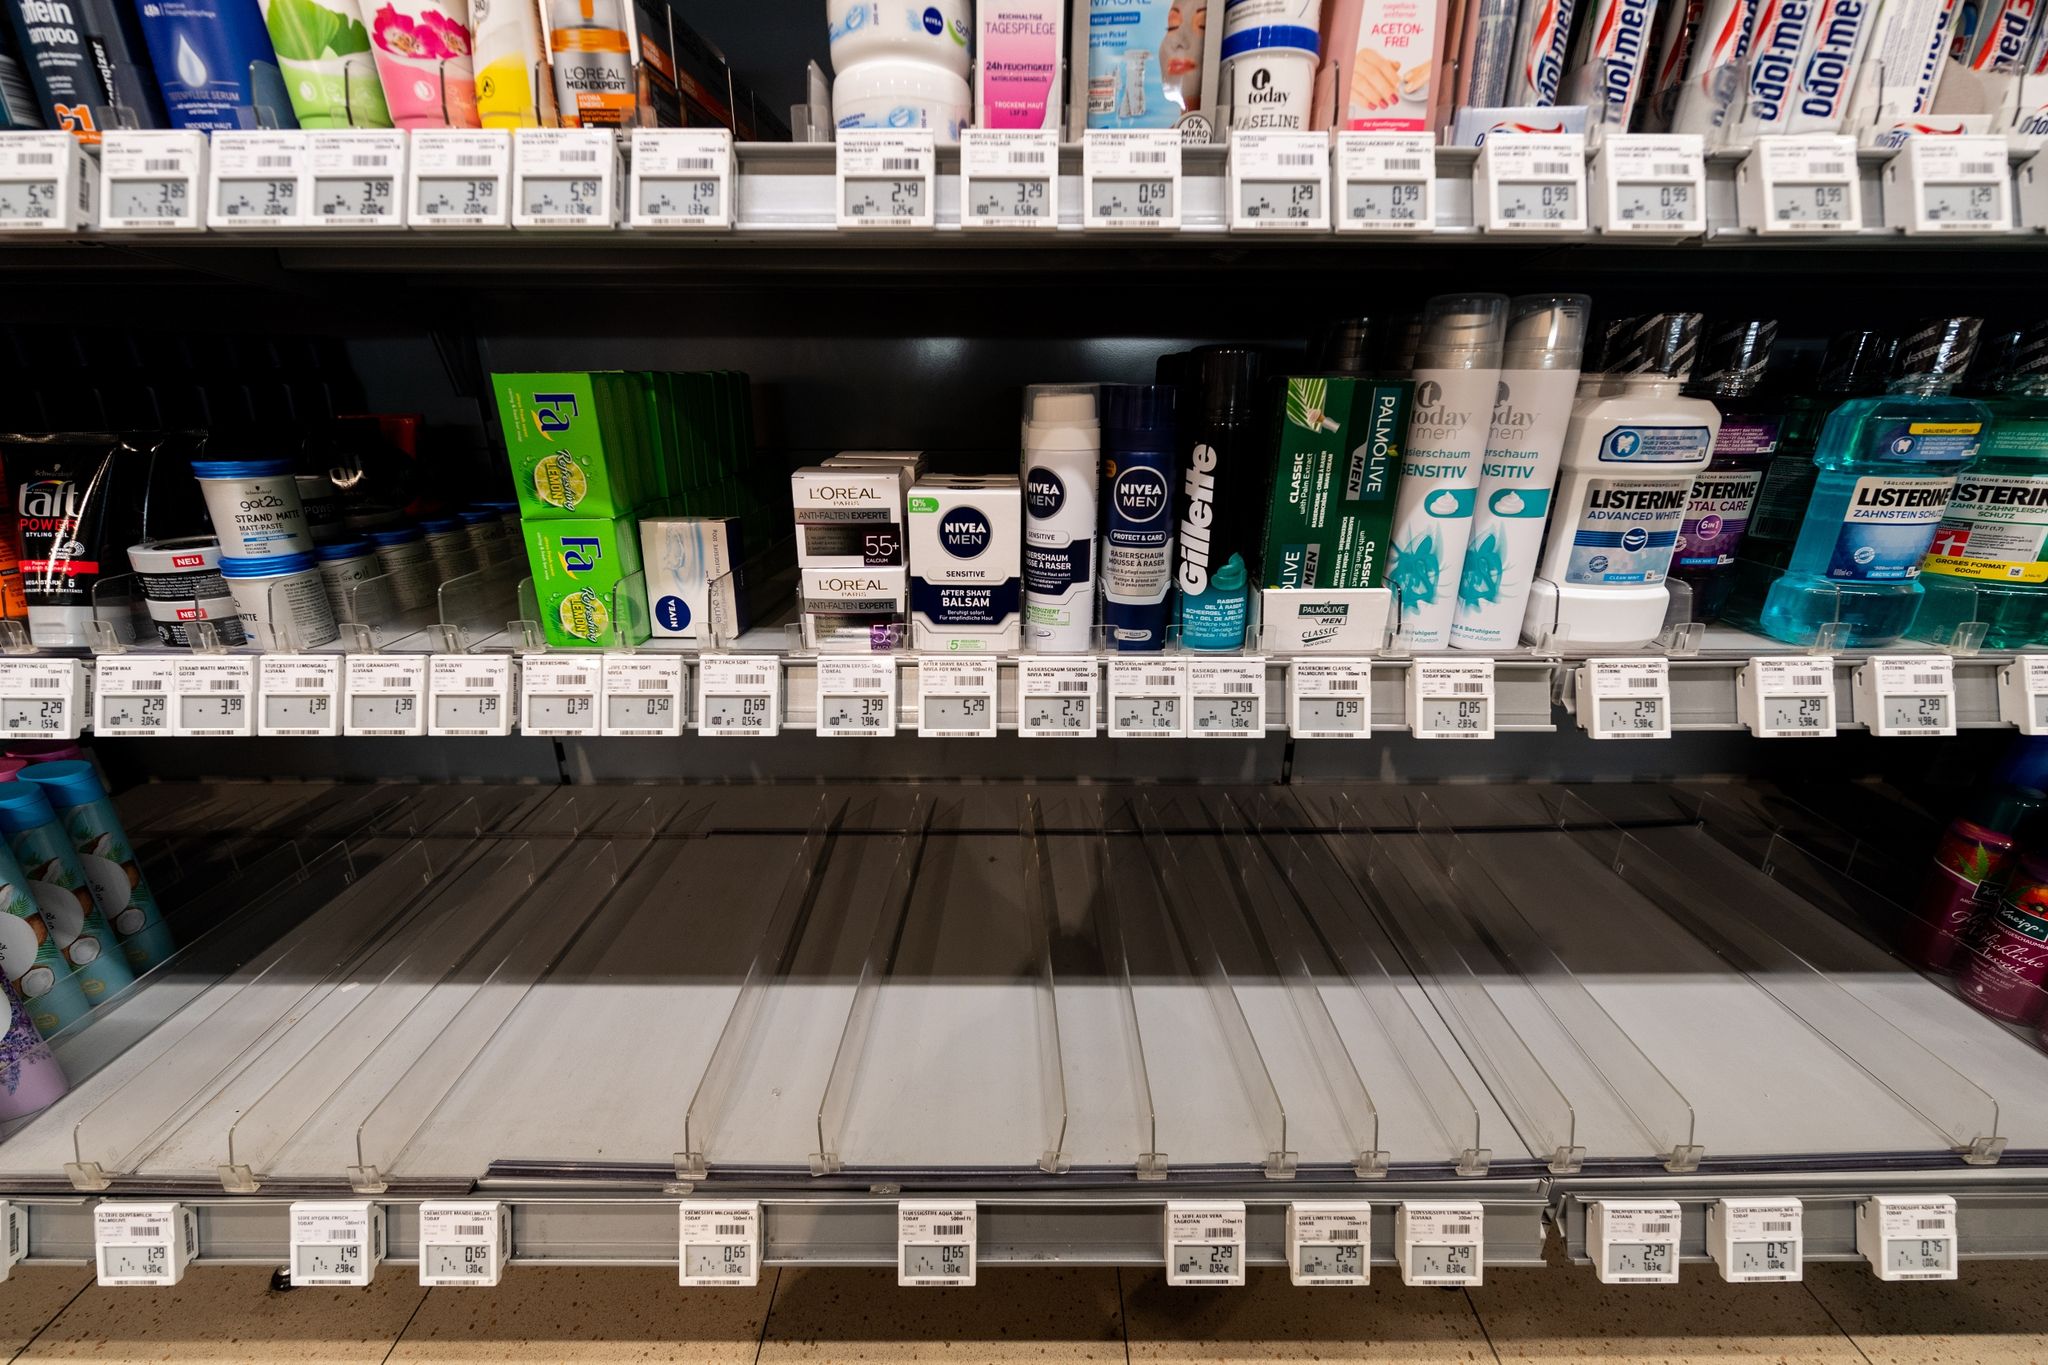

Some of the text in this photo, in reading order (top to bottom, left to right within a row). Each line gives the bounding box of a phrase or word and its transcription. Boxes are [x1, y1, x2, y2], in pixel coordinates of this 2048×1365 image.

[924, 16, 942, 28] NIVEA
[998, 13, 1043, 21] REICHHALTIGE
[985, 22, 1056, 36] TAGESPFLEGE
[1371, 24, 1424, 35] ACETON-
[1384, 37, 1410, 48] FREI
[986, 61, 1054, 72] 24h FEUCHTIGKEIT
[566, 81, 627, 90] MEN EXPERT
[1248, 87, 1290, 106] today
[994, 101, 1044, 110] TROCKENE HAUT
[1187, 119, 1203, 129] 0%
[1181, 130, 1208, 139] MIKRO
[267, 182, 294, 205] 3.99
[363, 182, 390, 205] 3.99
[467, 182, 493, 204] 3.99
[891, 182, 919, 204] 2.49
[1017, 182, 1043, 204] 3.29
[1138, 182, 1166, 205] 0.69
[1291, 184, 1314, 206] 1.29
[1391, 184, 1419, 206] 0.99
[533, 392, 578, 432] Fa
[1415, 427, 1457, 440] men
[1366, 395, 1396, 494] PALMOLIVE
[546, 462, 562, 501] LEMON
[556, 447, 576, 513] Refreshing
[1289, 452, 1305, 504] CLASSIC
[1348, 454, 1364, 493] MEN
[809, 485, 882, 500] L'ORÉAL
[1120, 483, 1162, 495] NIVEA
[1299, 453, 1313, 515] with Palm Extract
[1690, 481, 1757, 499] STERINE
[18, 480, 79, 517] taft
[239, 495, 284, 512] got2b
[912, 499, 927, 508] 0%
[1123, 496, 1158, 507] MEN
[1589, 490, 1688, 510] LISTERINE
[1720, 500, 1749, 511] CARE
[1856, 488, 1951, 507] LISTERINE
[1950, 502, 1976, 510] ZAHN
[234, 509, 300, 524] STRAND MATTE
[798, 511, 889, 521] ANTI-FALTEN EXPERTE
[1179, 443, 1218, 596] Gillette
[1587, 510, 1682, 521] ADVANCED WHITE
[1853, 509, 1944, 519] ZAHNSTEIN SCHUTZ
[1977, 511, 2015, 520] SCHUTZ
[19, 518, 78, 532] POWER
[239, 522, 285, 532] MATT-PASTE
[944, 522, 987, 534] NIVEA
[865, 534, 900, 556] 55+
[948, 534, 983, 545] MEN
[1113, 533, 1163, 541] PROTECT & CARE
[176, 555, 200, 567] NEU
[560, 536, 602, 573] Fa
[1110, 550, 1164, 560] RASIERSCHAUM
[1047, 560, 1072, 570] RASER
[1108, 559, 1165, 568] MOUSSE RASER
[1303, 550, 1318, 587] MEN
[1360, 541, 1375, 587] CLASSIC
[1954, 567, 1981, 575] 600ml
[1970, 562, 2006, 571] FORMAT
[945, 570, 986, 578] SENSITIVE
[68, 578, 75, 588] 5
[818, 577, 888, 591] L'ORÉAL
[940, 589, 992, 597] AFTER SHAVE
[807, 601, 895, 610] ANTI-FALTEN EXPERTE
[942, 597, 990, 607] BALSAM
[1302, 604, 1345, 615] PALMOLIVE
[570, 598, 583, 633] LEMON
[581, 585, 598, 643] Refreshing
[668, 599, 679, 628] NIVEA
[949, 614, 979, 622] empfindliche
[1320, 617, 1343, 625] MEN
[1301, 626, 1339, 640] CLASSIC
[40, 701, 62, 718] 2.29
[142, 698, 164, 716] 2.29
[220, 698, 242, 715] 3.99
[309, 698, 326, 715] 1.39
[395, 698, 412, 715] 1.39
[479, 698, 496, 715] 1.39
[567, 698, 589, 715] 0.39
[647, 698, 669, 716] 0.50
[743, 698, 766, 716] 0.69
[862, 699, 884, 716] 3.99
[963, 699, 985, 716] 5.29
[1062, 699, 1084, 717] 2.19
[1151, 699, 1174, 717] 2.19
[1230, 699, 1253, 717] 2.59
[1335, 700, 1358, 718] 0.99
[1458, 700, 1481, 718] 0.85
[1634, 700, 1657, 718] 2.99
[1799, 698, 1821, 717] 2.99
[1919, 698, 1940, 716] 2.99
[2000, 905, 2039, 932] Kneipp
[148, 1246, 165, 1263] 1.29
[340, 1246, 358, 1263] 1.49
[465, 1246, 487, 1263] 0.65
[724, 1245, 745, 1263] 0.65
[942, 1246, 964, 1263] 0.65
[1210, 1246, 1233, 1263] 2.29
[1336, 1246, 1358, 1263] 2.95
[1448, 1246, 1470, 1263] 2.49
[1643, 1244, 1666, 1261] 2.29
[1767, 1241, 1788, 1260] 0.75
[1920, 1240, 1943, 1258] 0.75
